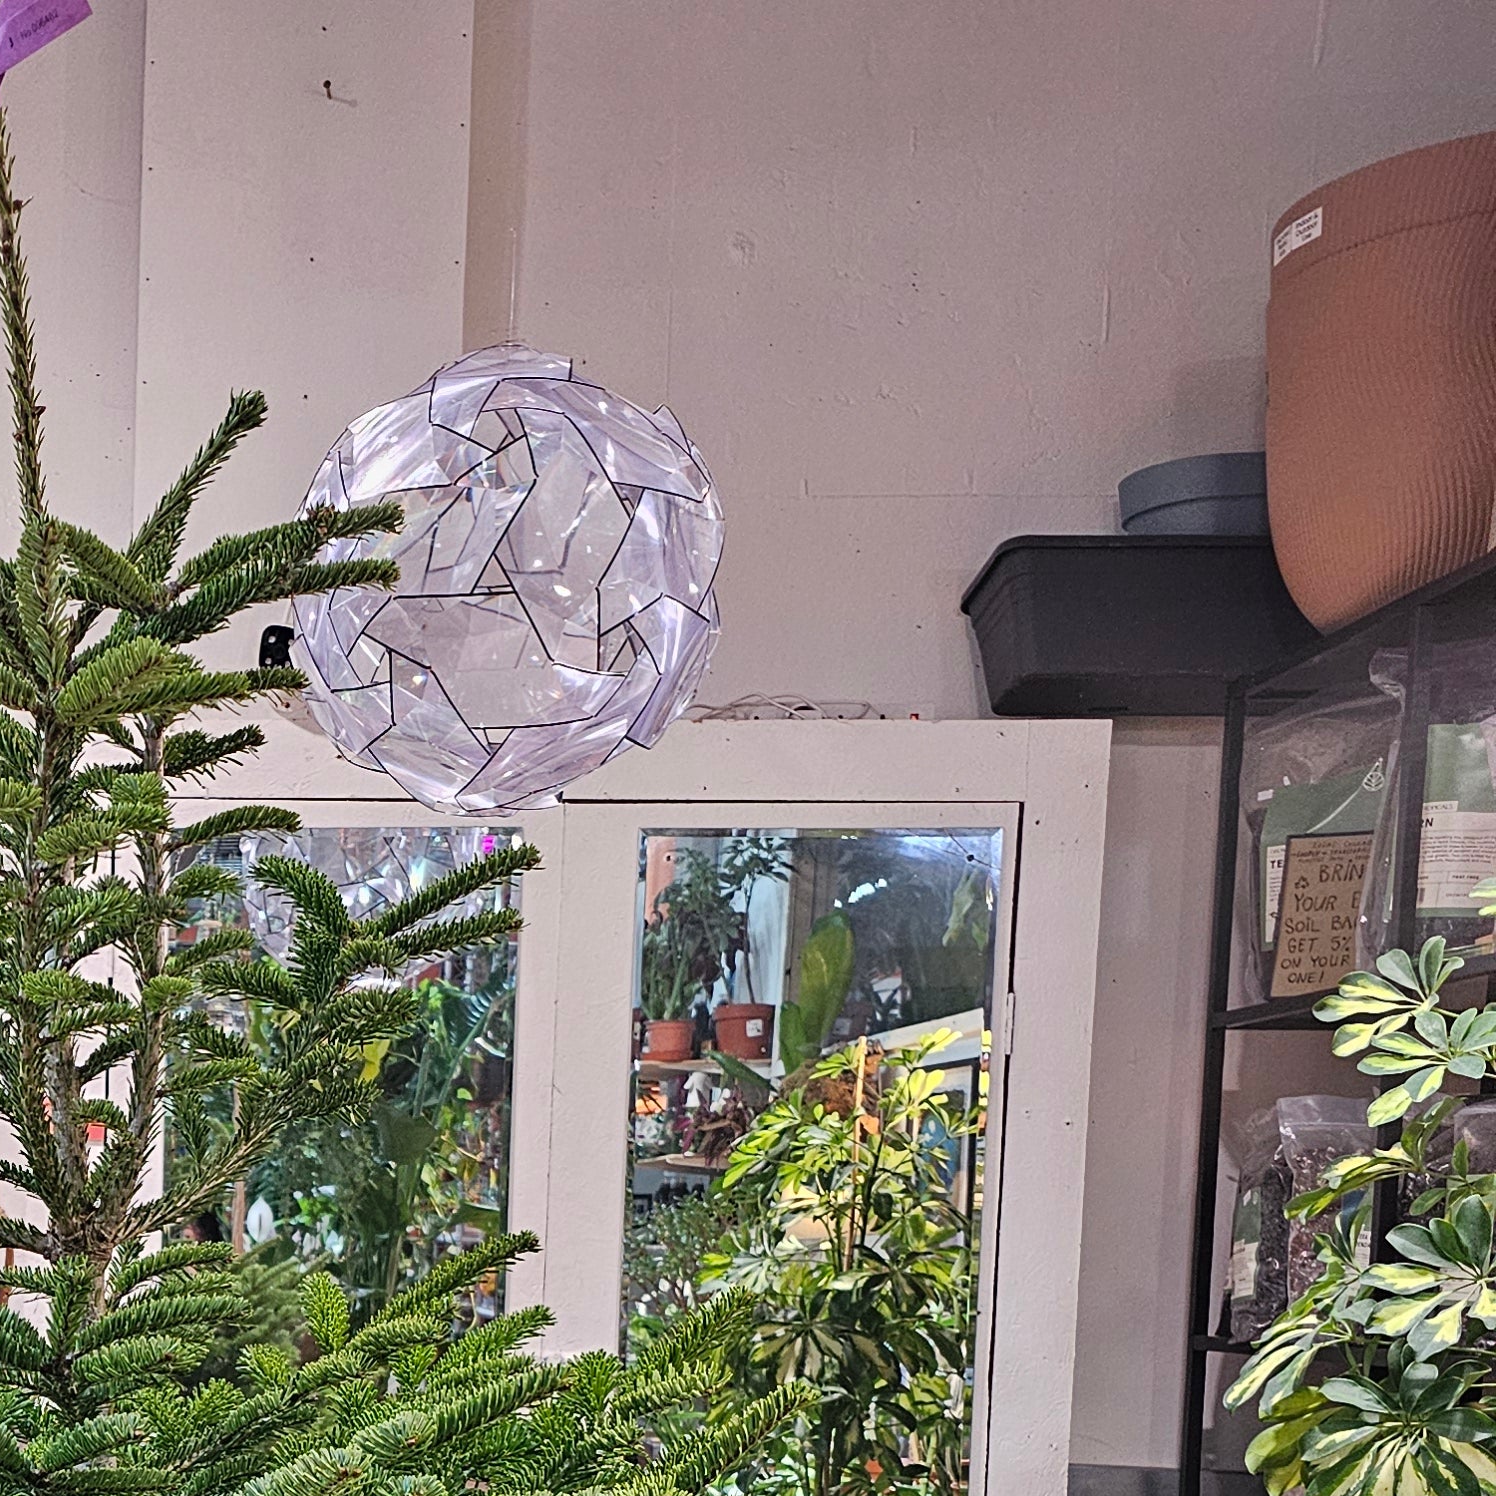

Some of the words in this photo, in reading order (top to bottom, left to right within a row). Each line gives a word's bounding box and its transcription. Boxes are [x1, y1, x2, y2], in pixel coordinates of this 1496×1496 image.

[1270, 860, 1284, 869] TE
[1319, 859, 1364, 883] BRIN
[1294, 893, 1337, 912] YOUR
[1287, 937, 1319, 953] GET
[1330, 936, 1352, 952] 5%
[1281, 958, 1301, 969] ON
[1310, 954, 1350, 967] YOUR
[1287, 970, 1324, 984] ONE!
